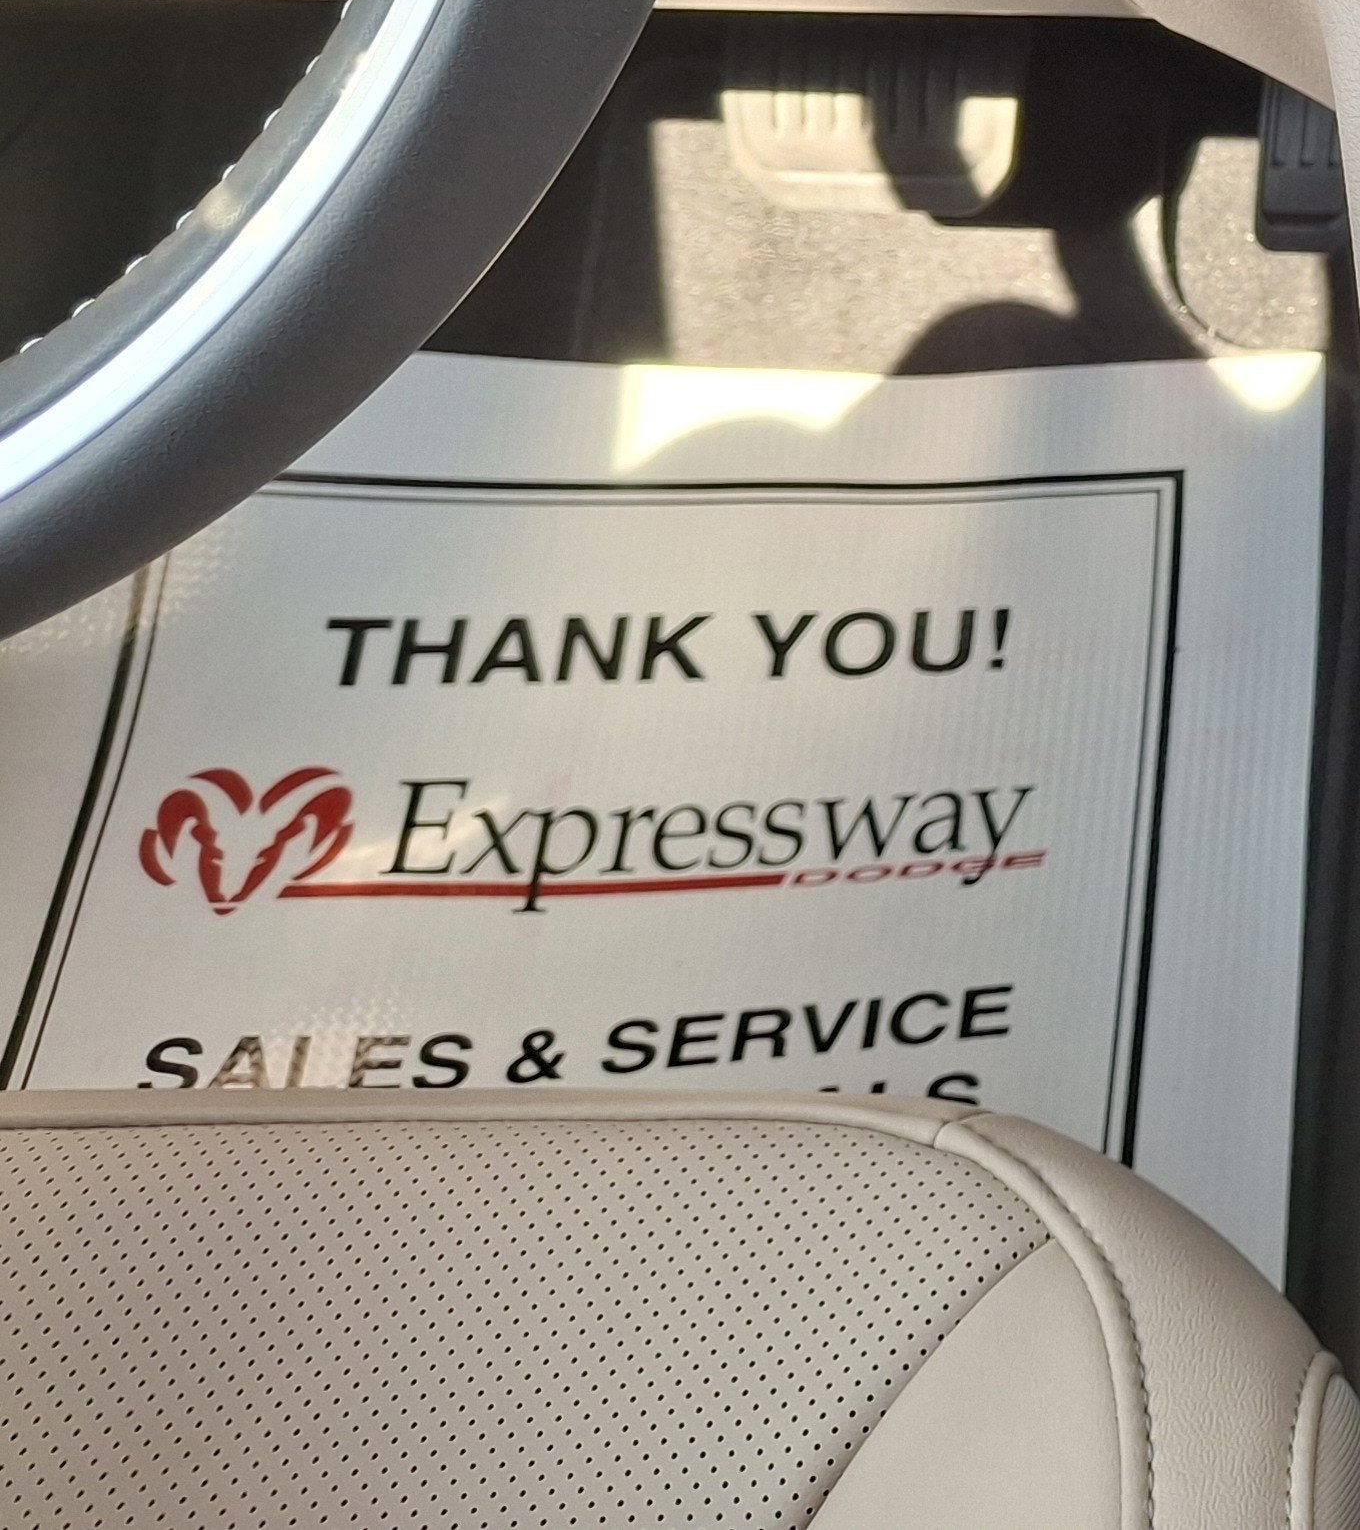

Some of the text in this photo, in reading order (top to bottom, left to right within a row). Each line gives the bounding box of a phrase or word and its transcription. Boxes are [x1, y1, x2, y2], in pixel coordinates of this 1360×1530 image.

[326, 607, 1013, 687] THANK YOU!
[380, 778, 1035, 913] Expressway
[794, 849, 1046, 887] DODGE
[506, 1030, 571, 1084] &
[602, 982, 1013, 1074] SERVICE
